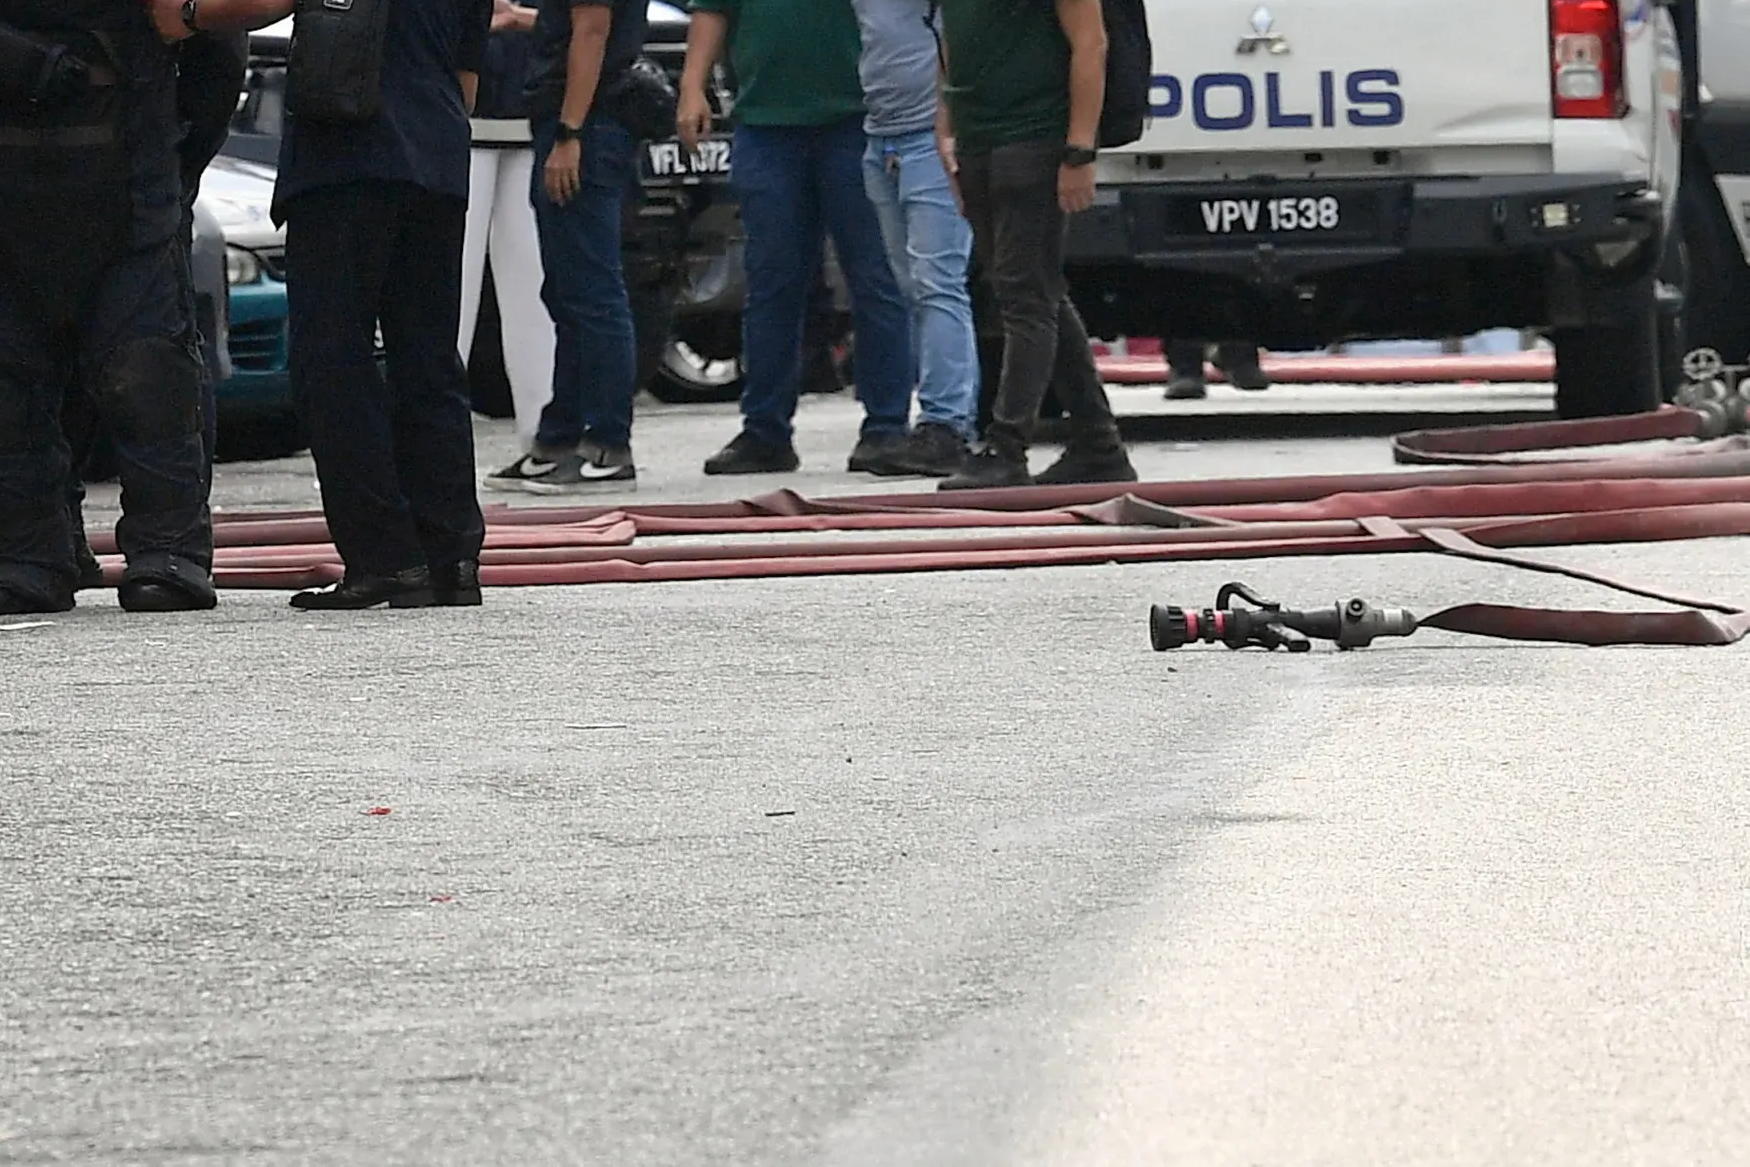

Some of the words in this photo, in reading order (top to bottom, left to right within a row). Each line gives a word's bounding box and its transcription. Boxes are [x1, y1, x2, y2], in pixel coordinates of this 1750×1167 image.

[1146, 69, 1404, 130] POLIS
[1201, 199, 1260, 233] VPV
[1267, 196, 1339, 231] 1538
